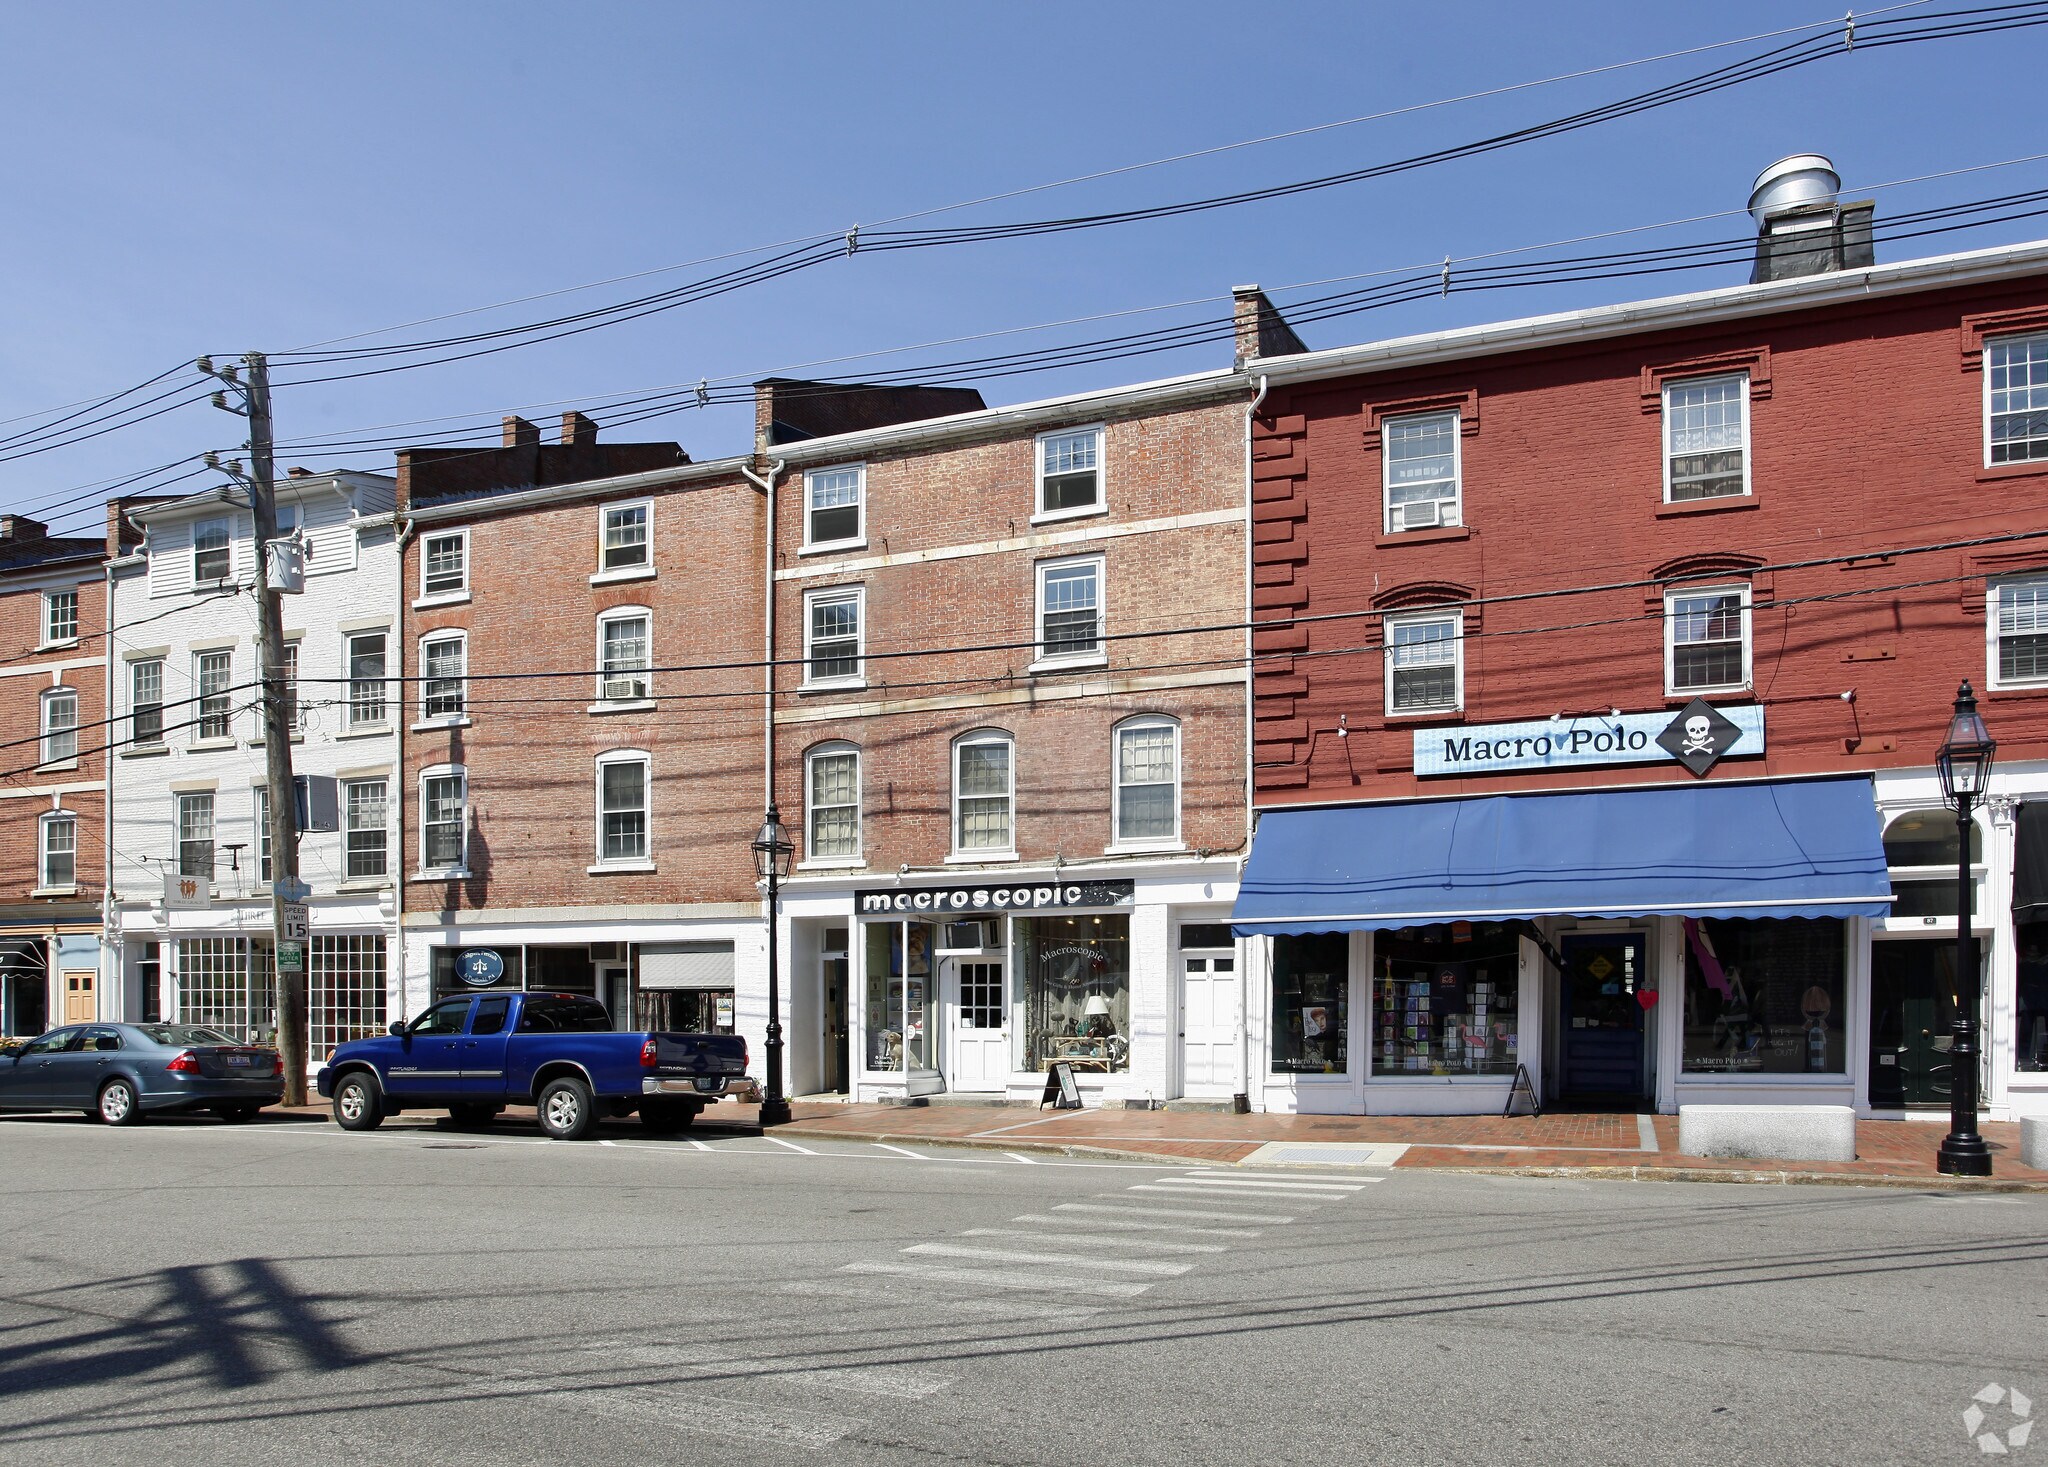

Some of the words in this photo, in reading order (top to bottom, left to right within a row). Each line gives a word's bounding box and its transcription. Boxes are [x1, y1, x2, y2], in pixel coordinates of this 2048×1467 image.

[1444, 732, 1552, 762] Macro
[1569, 727, 1647, 754] Polo
[863, 886, 1082, 911] macroscopic
[284, 906, 306, 914] SPEED
[286, 923, 307, 938] 15
[1039, 946, 1104, 963] Macroscopic
